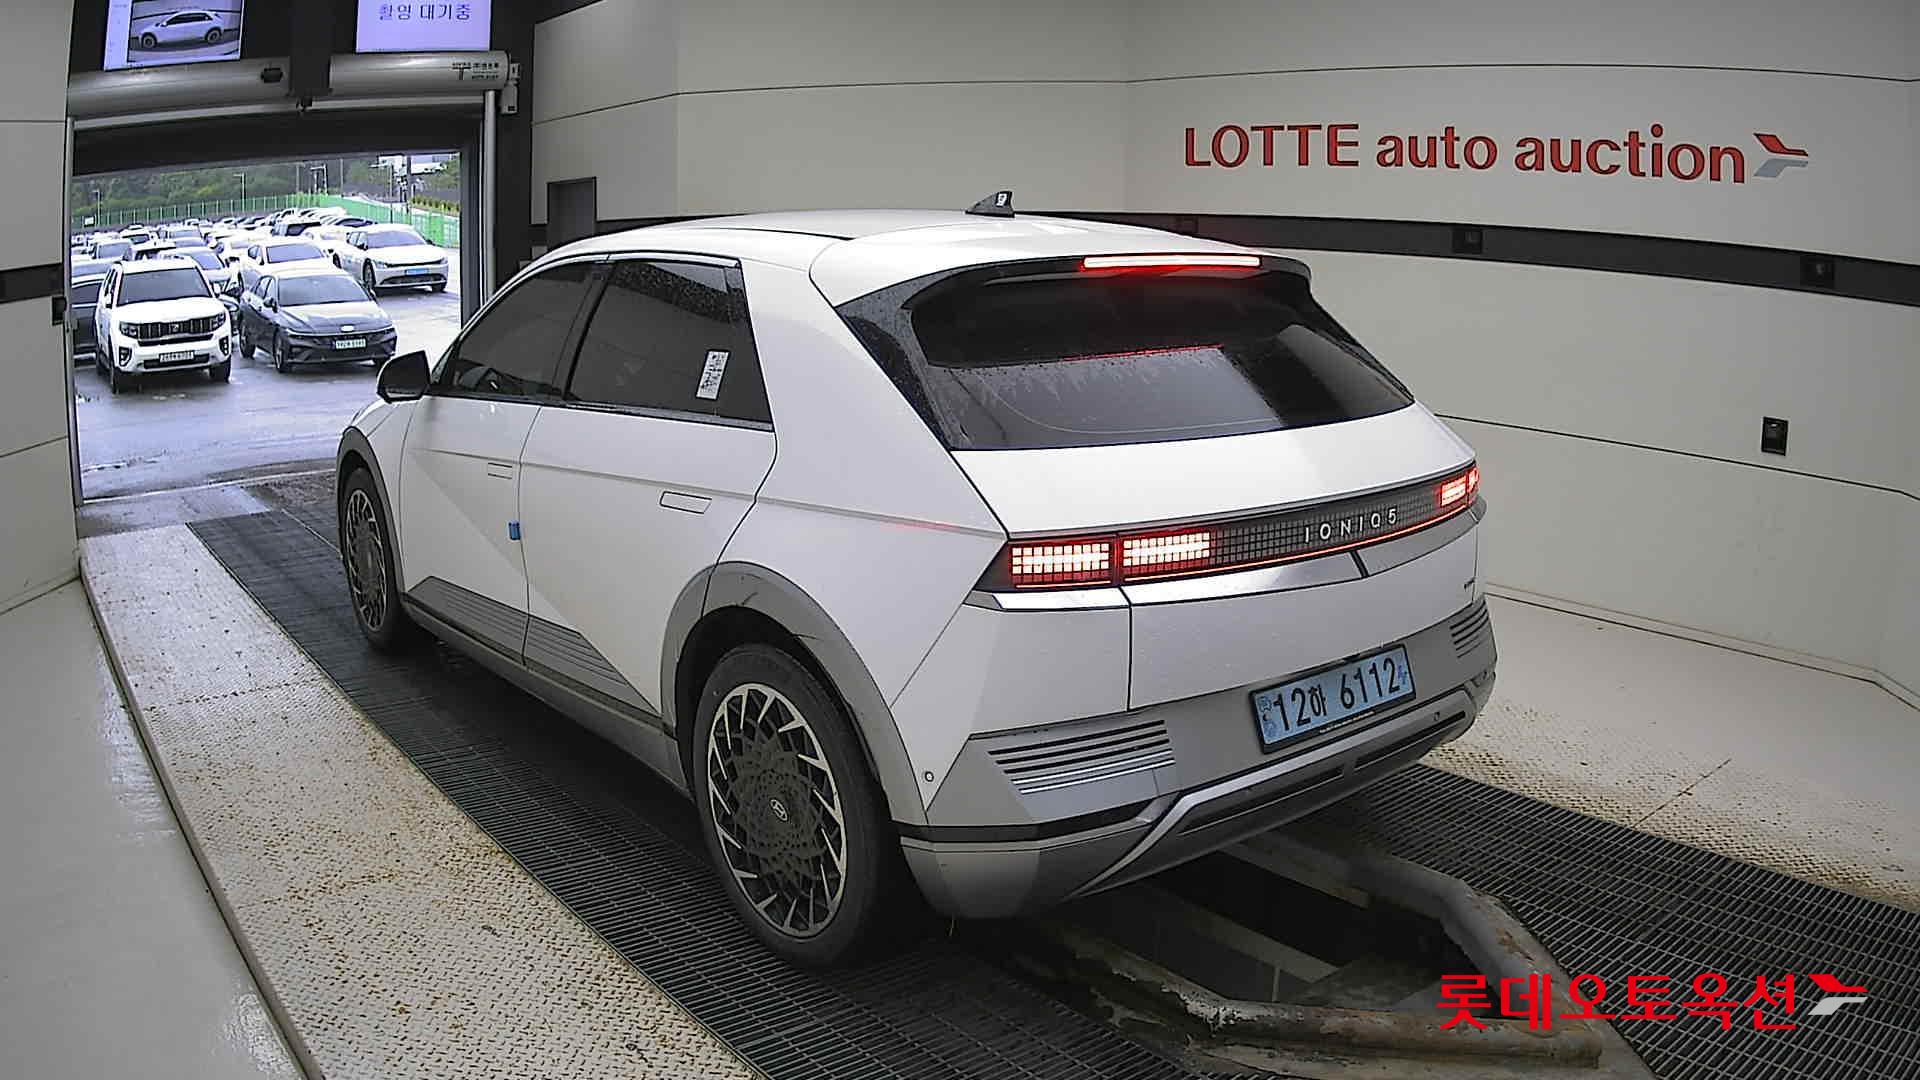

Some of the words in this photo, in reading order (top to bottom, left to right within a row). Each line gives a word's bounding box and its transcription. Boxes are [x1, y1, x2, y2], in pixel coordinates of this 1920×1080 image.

[420, 3, 472, 21] 대기중
[1185, 122, 1361, 169] LOTTE
[1375, 125, 1498, 171] auto
[1513, 122, 1746, 184] auction
[1273, 684, 1328, 731] 12하
[1340, 657, 1401, 710] 6112
